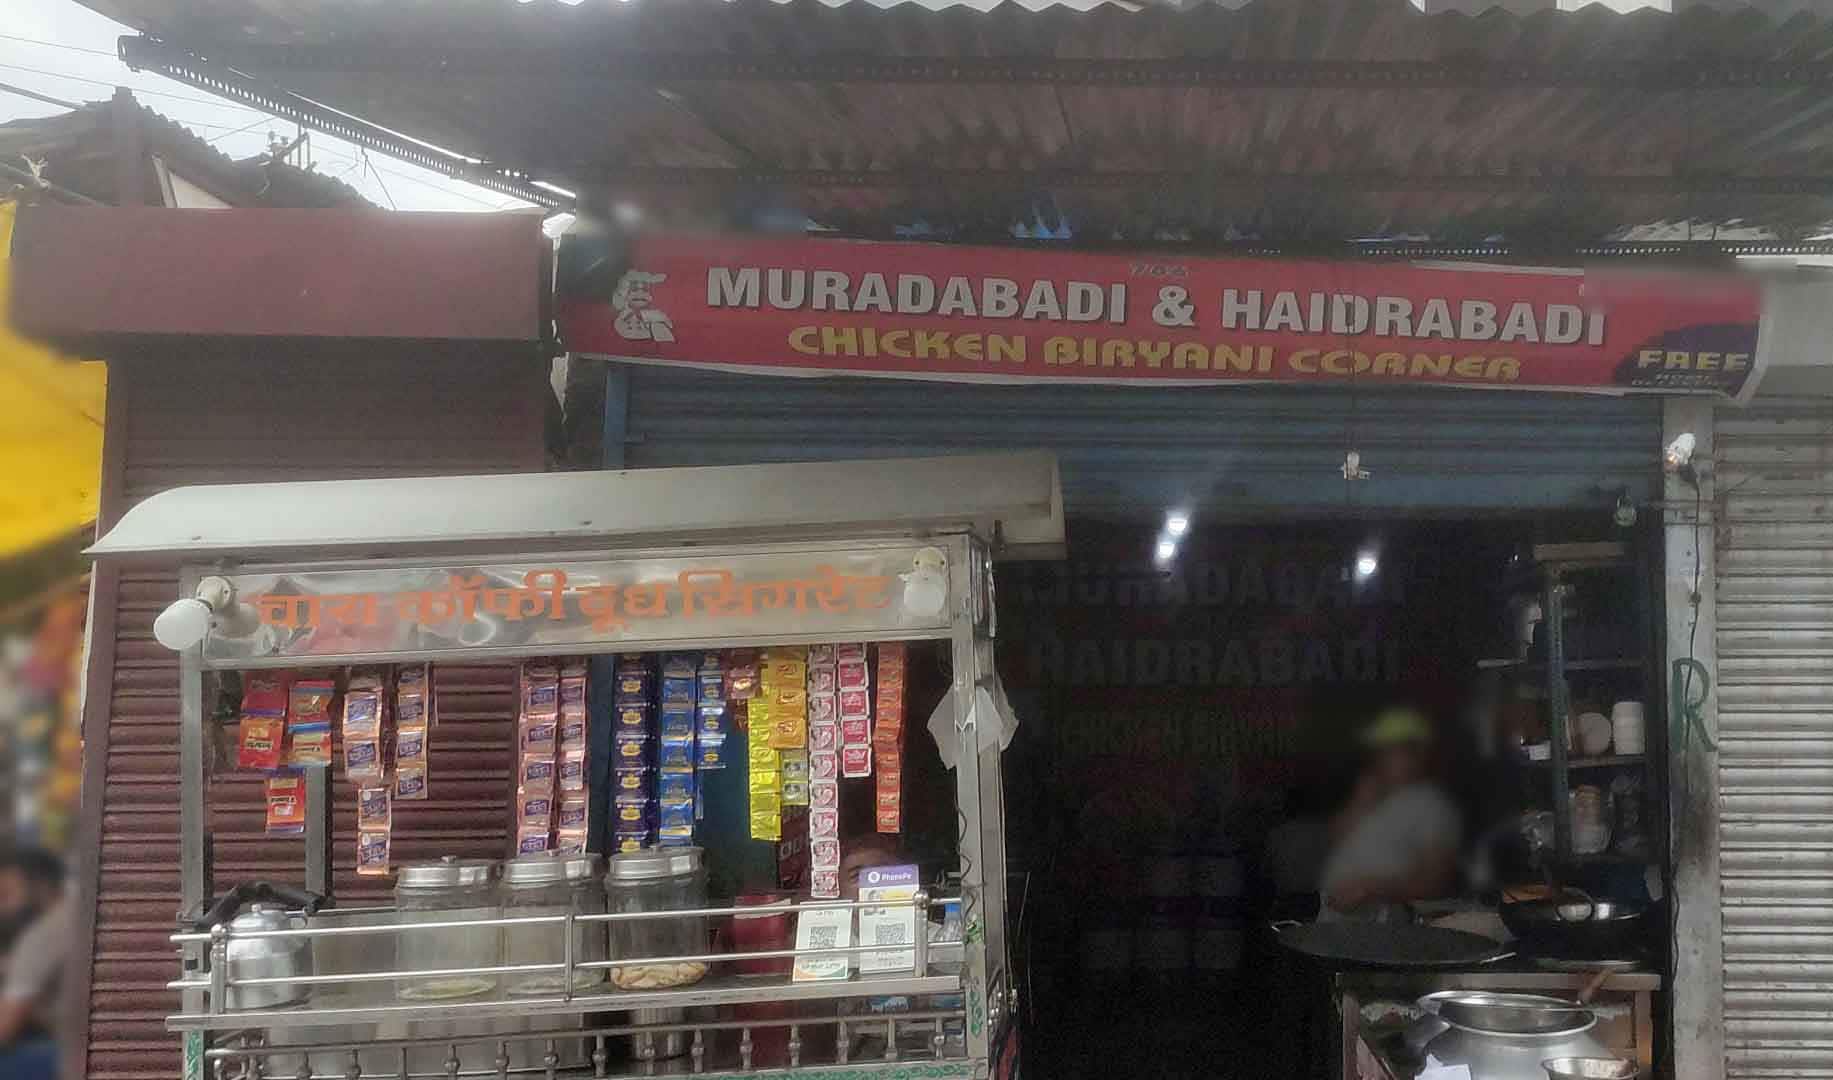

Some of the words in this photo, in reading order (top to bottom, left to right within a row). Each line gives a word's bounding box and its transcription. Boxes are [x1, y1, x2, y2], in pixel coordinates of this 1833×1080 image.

[707, 267, 1126, 325] MURADABADI
[1152, 285, 1195, 328] &
[1221, 288, 1605, 345] HAIDRABADI
[788, 325, 1027, 364] CHICKEN
[1042, 336, 1275, 374] BIRYANI
[1289, 349, 1523, 381] CORNER
[1637, 349, 1749, 371] FREE
[399, 568, 568, 621] कॉफी
[575, 583, 669, 634] दूध
[1671, 657, 1718, 752] R
